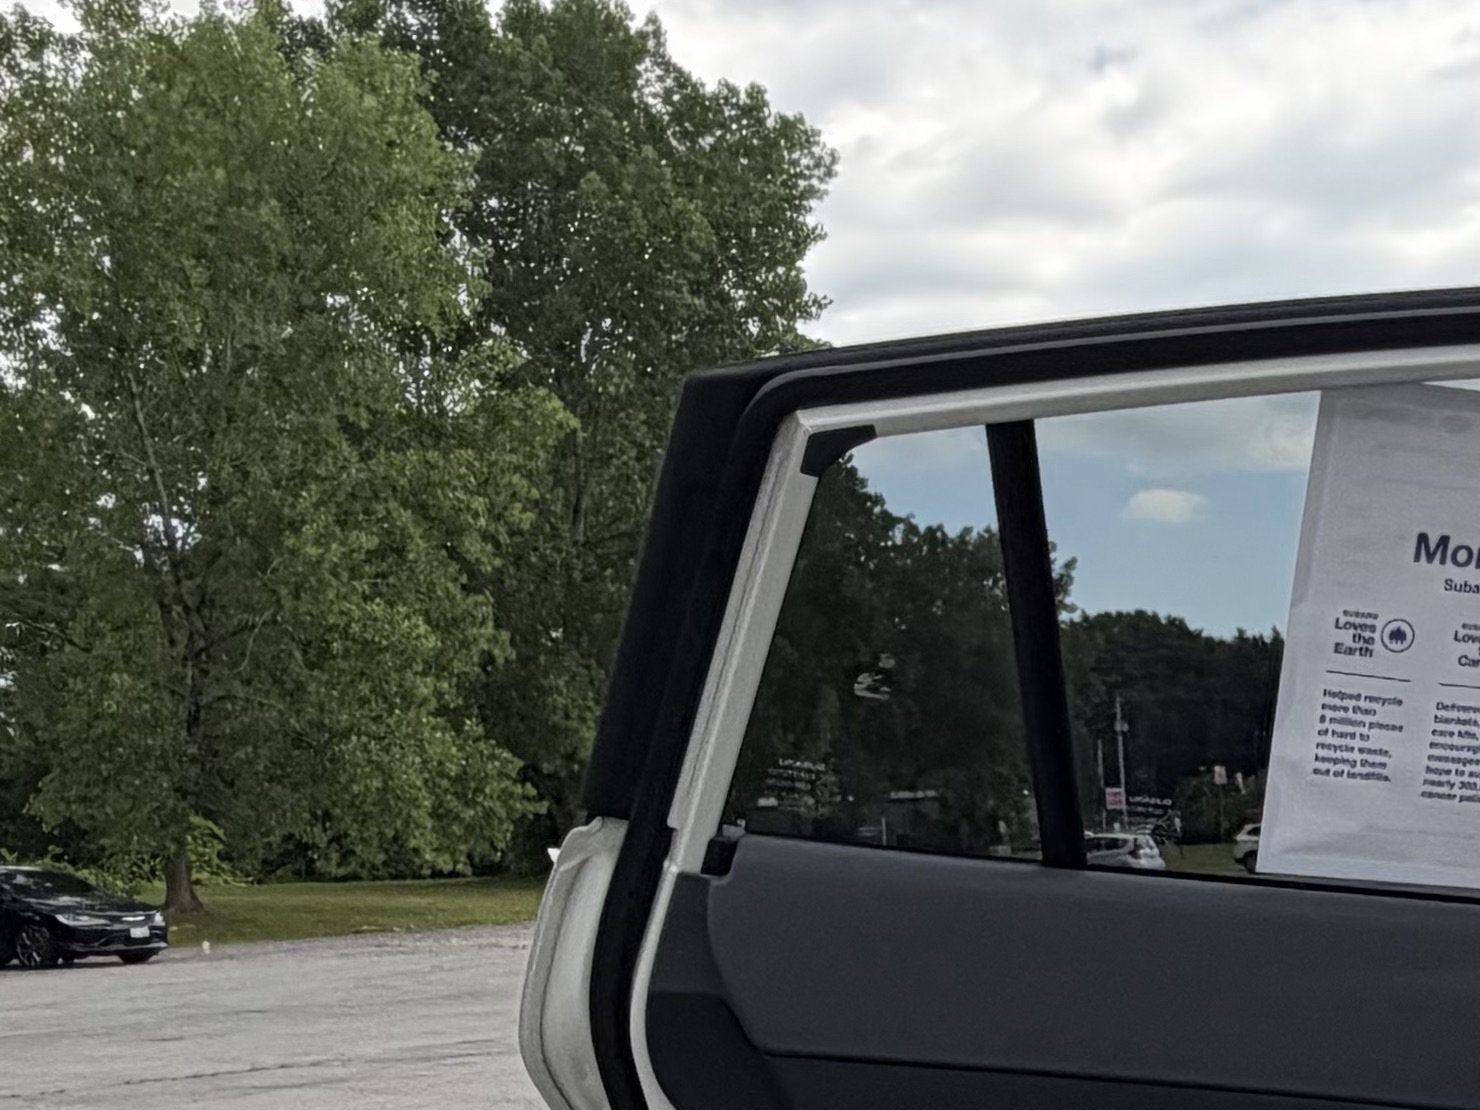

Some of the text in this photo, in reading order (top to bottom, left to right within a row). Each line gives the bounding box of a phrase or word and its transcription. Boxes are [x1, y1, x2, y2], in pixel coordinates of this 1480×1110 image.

[1334, 617, 1377, 633] Loves
[1352, 633, 1375, 645] the
[1334, 642, 1374, 658] Earth
